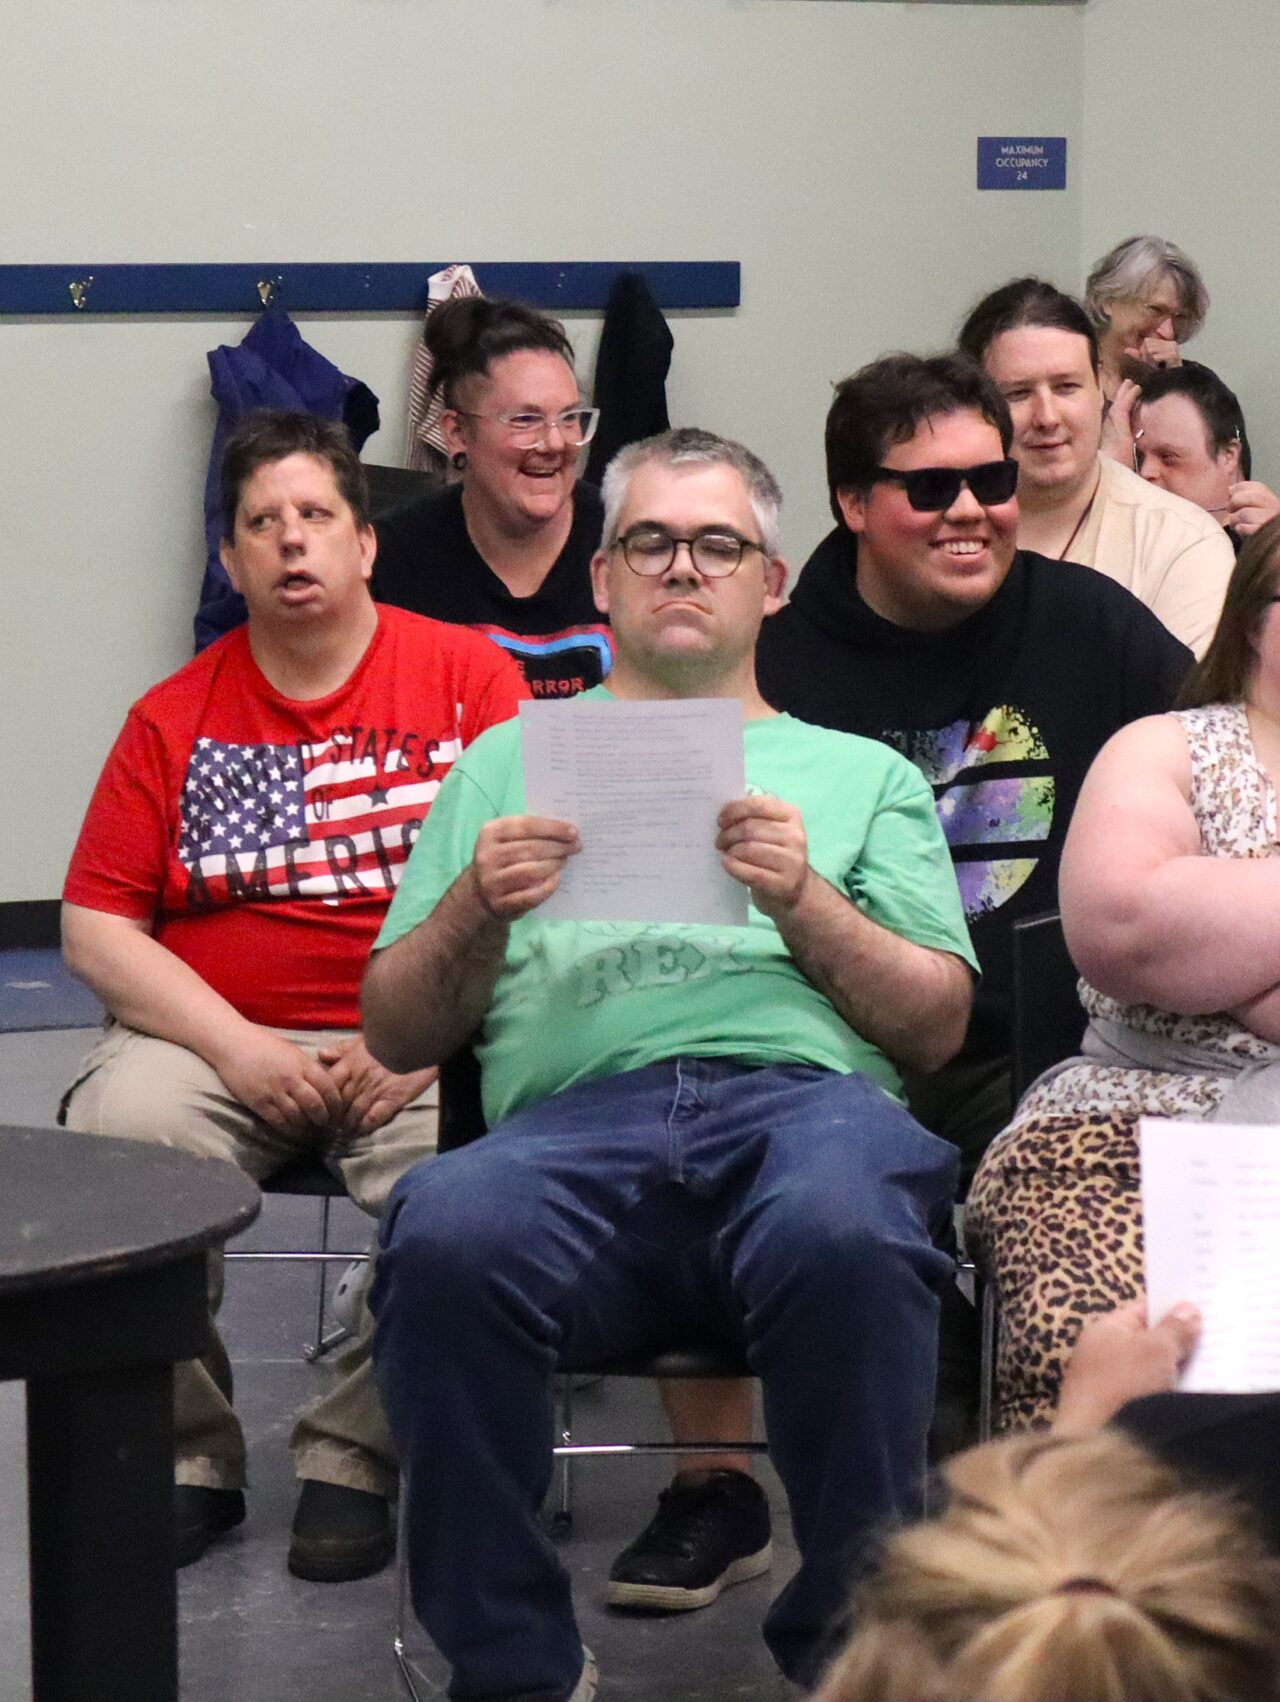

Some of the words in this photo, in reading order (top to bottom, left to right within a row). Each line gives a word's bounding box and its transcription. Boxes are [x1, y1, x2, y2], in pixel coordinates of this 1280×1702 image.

[1001, 145, 1044, 155] MAXIMUM
[995, 158, 1048, 168] OCCUPANCY
[1016, 170, 1028, 181] 24
[531, 677, 585, 695] RROR
[328, 725, 441, 778] STATES
[311, 786, 335, 822] OF
[186, 817, 424, 905] AMERIC
